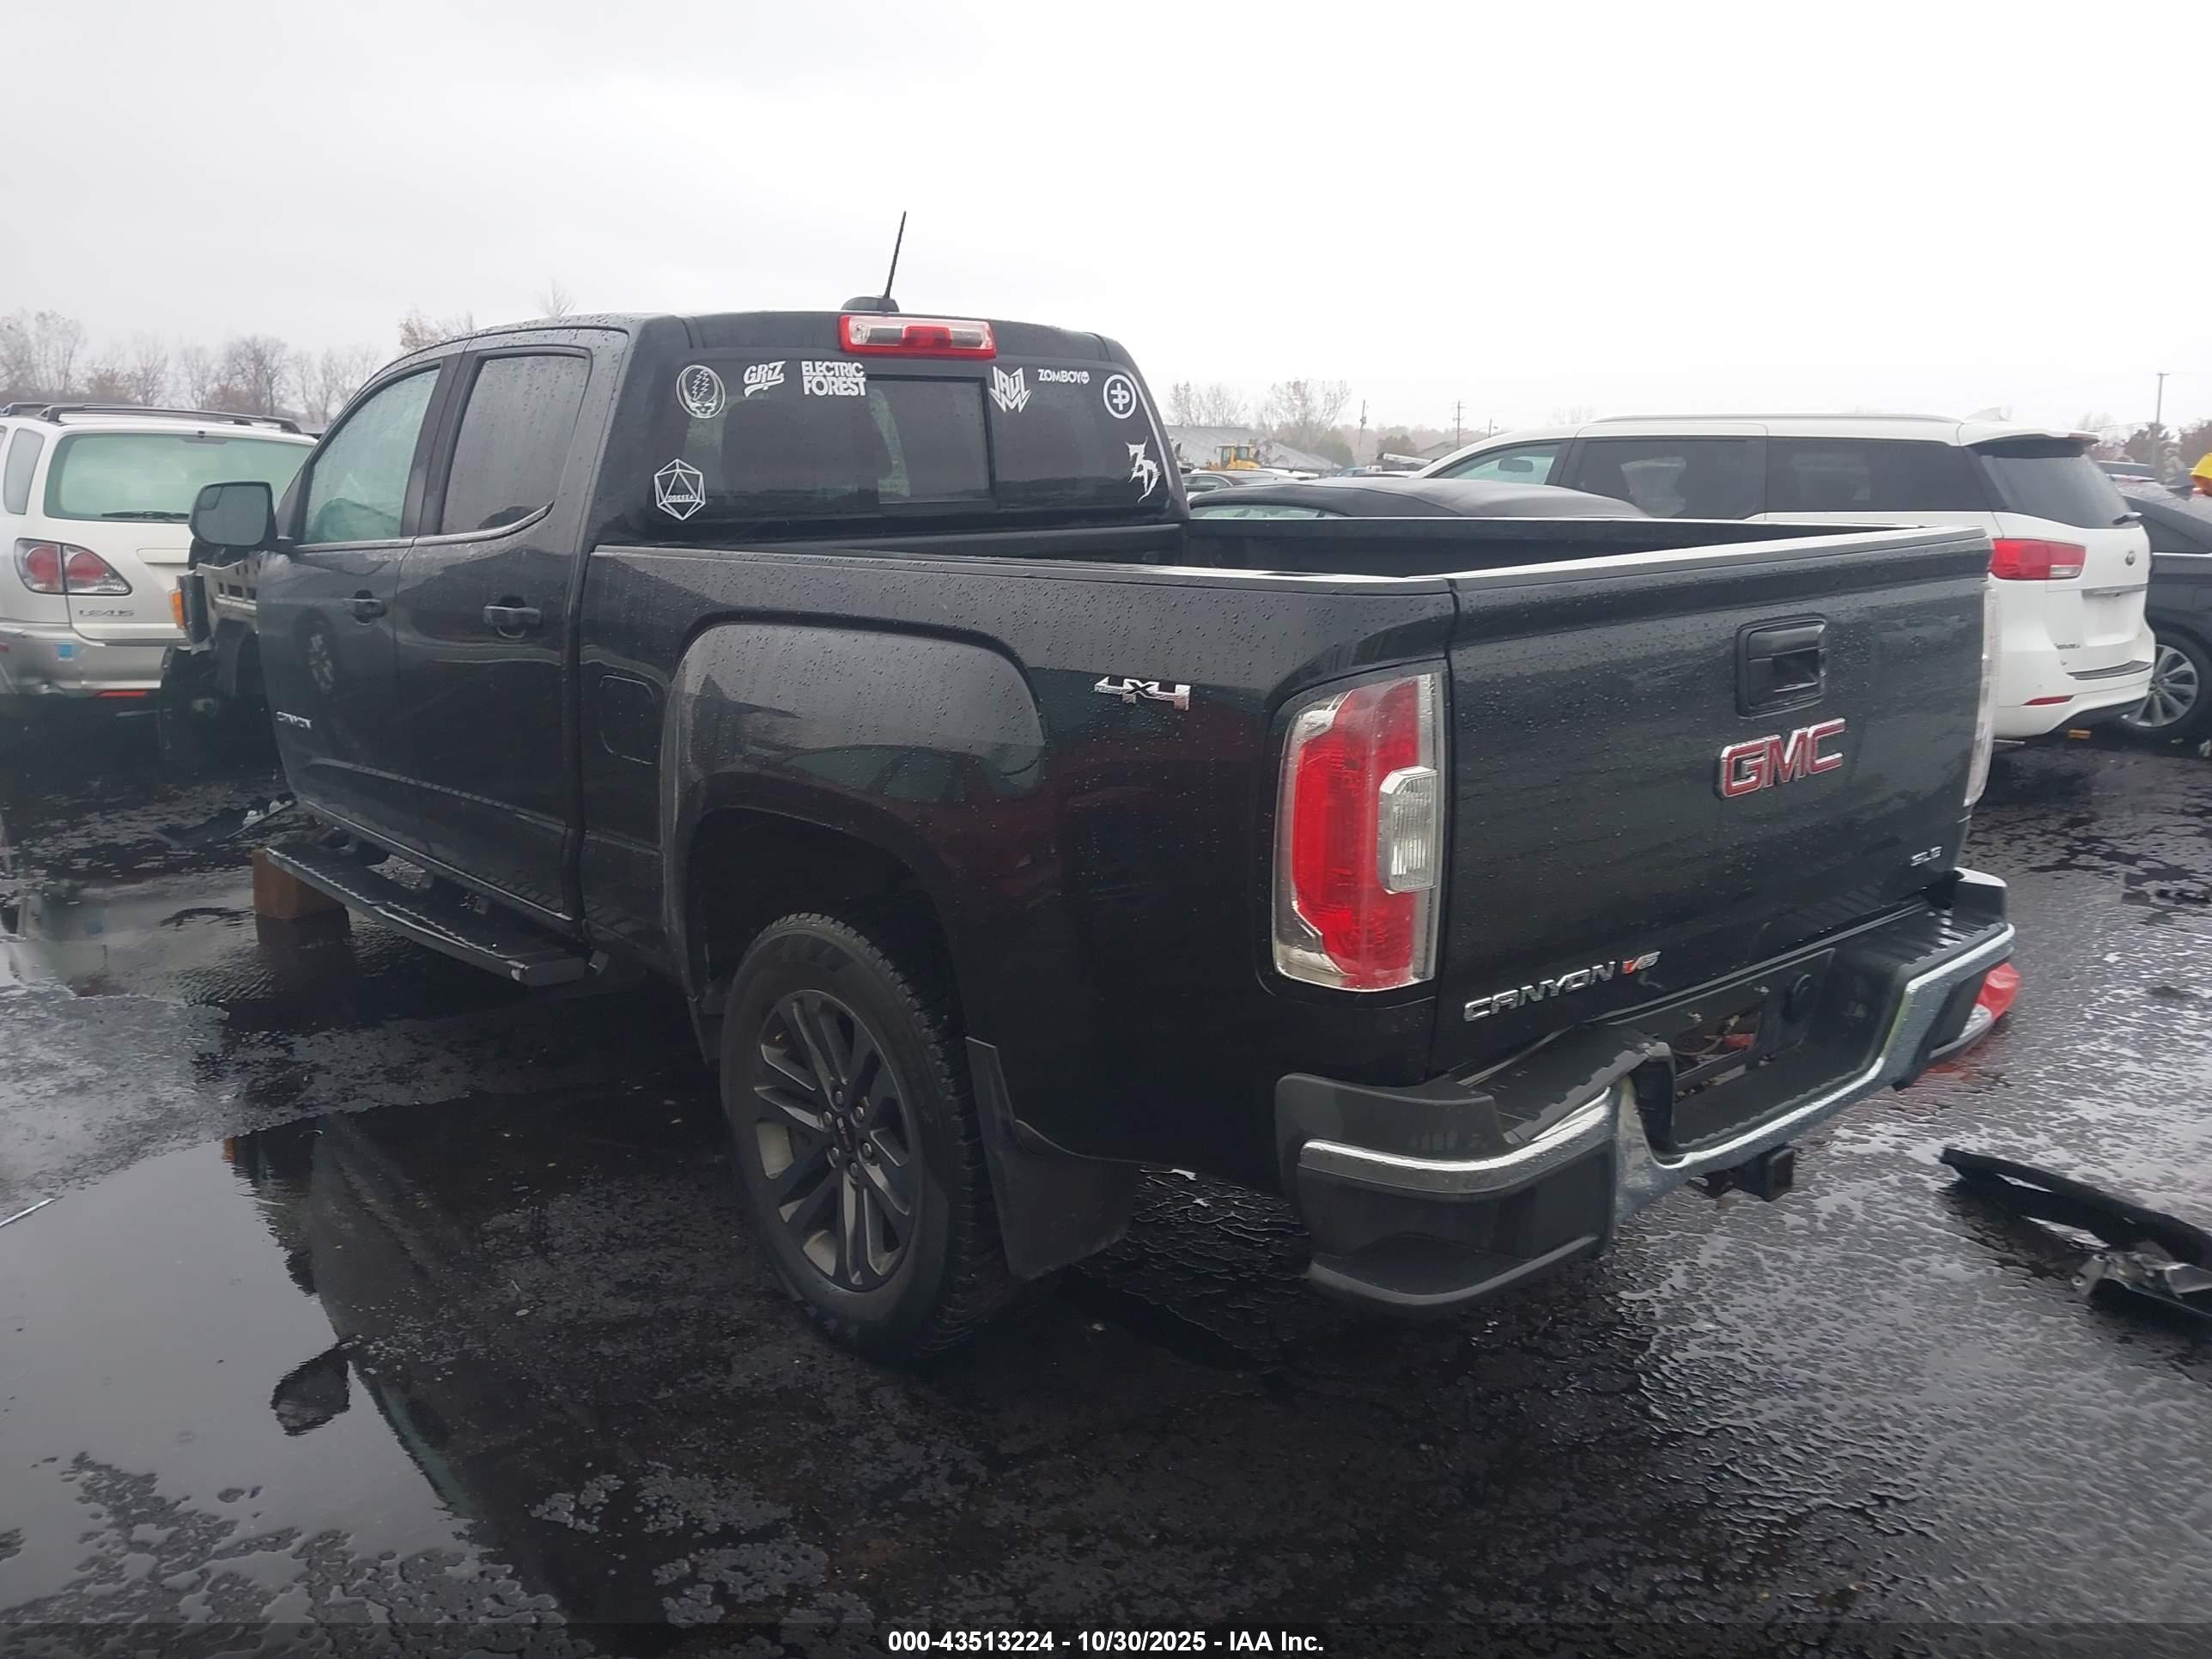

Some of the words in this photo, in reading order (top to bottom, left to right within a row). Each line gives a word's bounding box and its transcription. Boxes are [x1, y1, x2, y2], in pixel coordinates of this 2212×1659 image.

[800, 361, 866, 377] ELECTRIC
[1037, 368, 1082, 384] ZOMBOY
[802, 376, 866, 396] FOREST
[1720, 717, 1845, 798] GMC
[1463, 961, 1616, 1022] CANYON
[1621, 951, 1662, 975] V6
